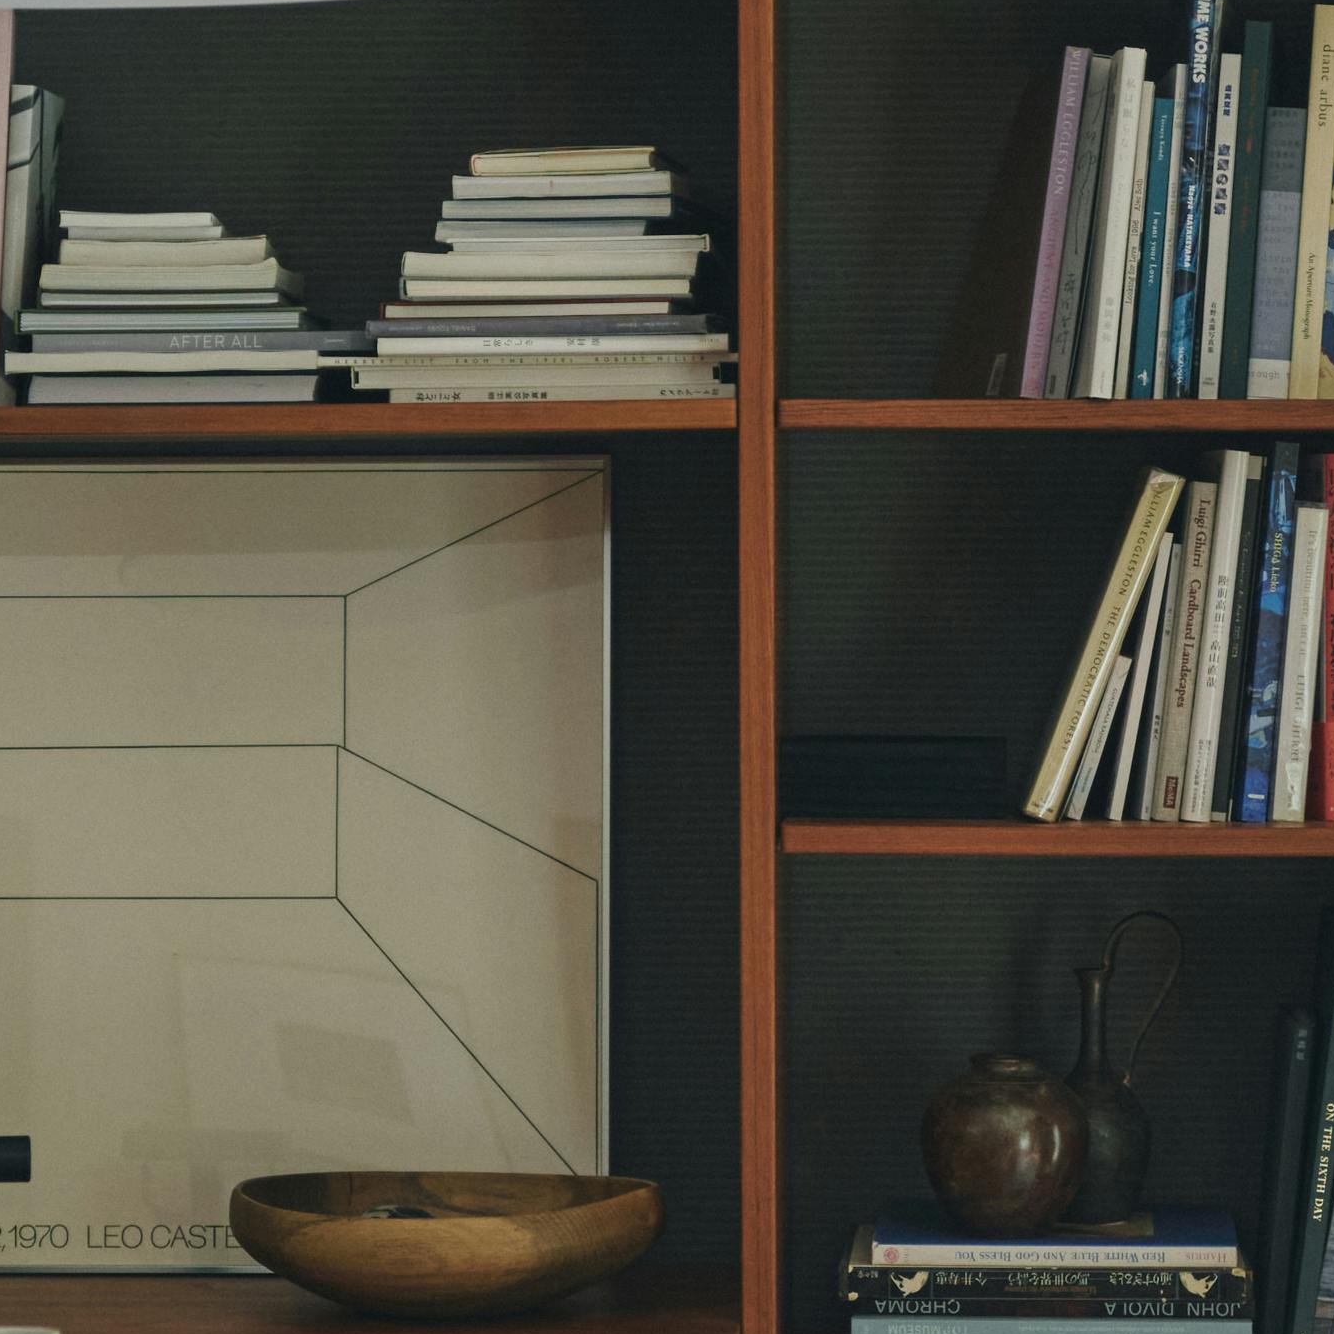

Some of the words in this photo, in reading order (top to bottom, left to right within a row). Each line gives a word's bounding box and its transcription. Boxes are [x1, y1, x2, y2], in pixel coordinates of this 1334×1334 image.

[1192, 27, 1209, 84] WORKS
[169, 334, 224, 350] AFTER
[232, 334, 263, 350] ALL
[1195, 499, 1211, 528] Luigi
[1192, 531, 1208, 567] Ghirri
[1183, 579, 1202, 640] Cardboard
[1176, 643, 1195, 708] Landscapes
[1320, 1126, 1334, 1152] THE
[1316, 1156, 1330, 1193] SIXTH
[1311, 1196, 1326, 1222] DAY
[87, 1224, 143, 1249] LEO
